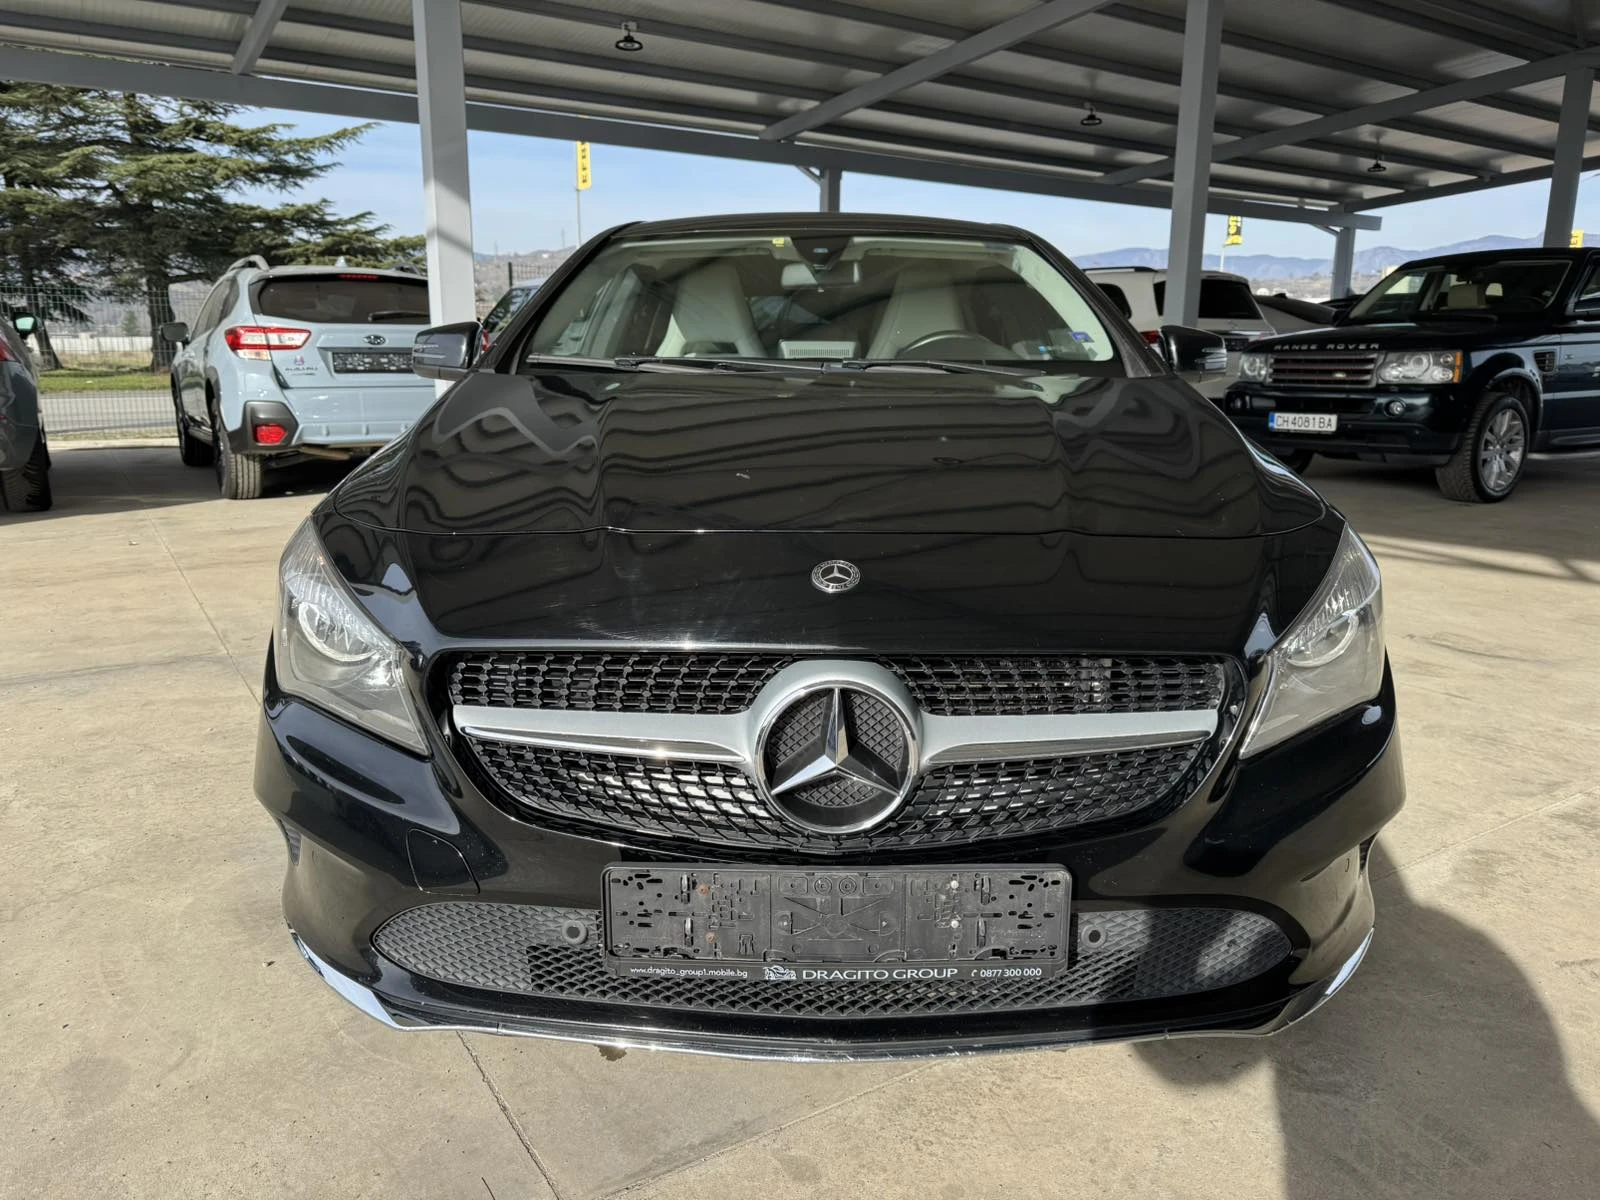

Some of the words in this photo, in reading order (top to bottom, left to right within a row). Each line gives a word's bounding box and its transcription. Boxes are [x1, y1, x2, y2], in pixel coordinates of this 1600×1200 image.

[802, 969, 889, 980] DRAGITO
[892, 968, 958, 979] GROUP
[980, 969, 1002, 978] 0877
[1003, 968, 1022, 977] 300
[1023, 967, 1042, 977] 000
